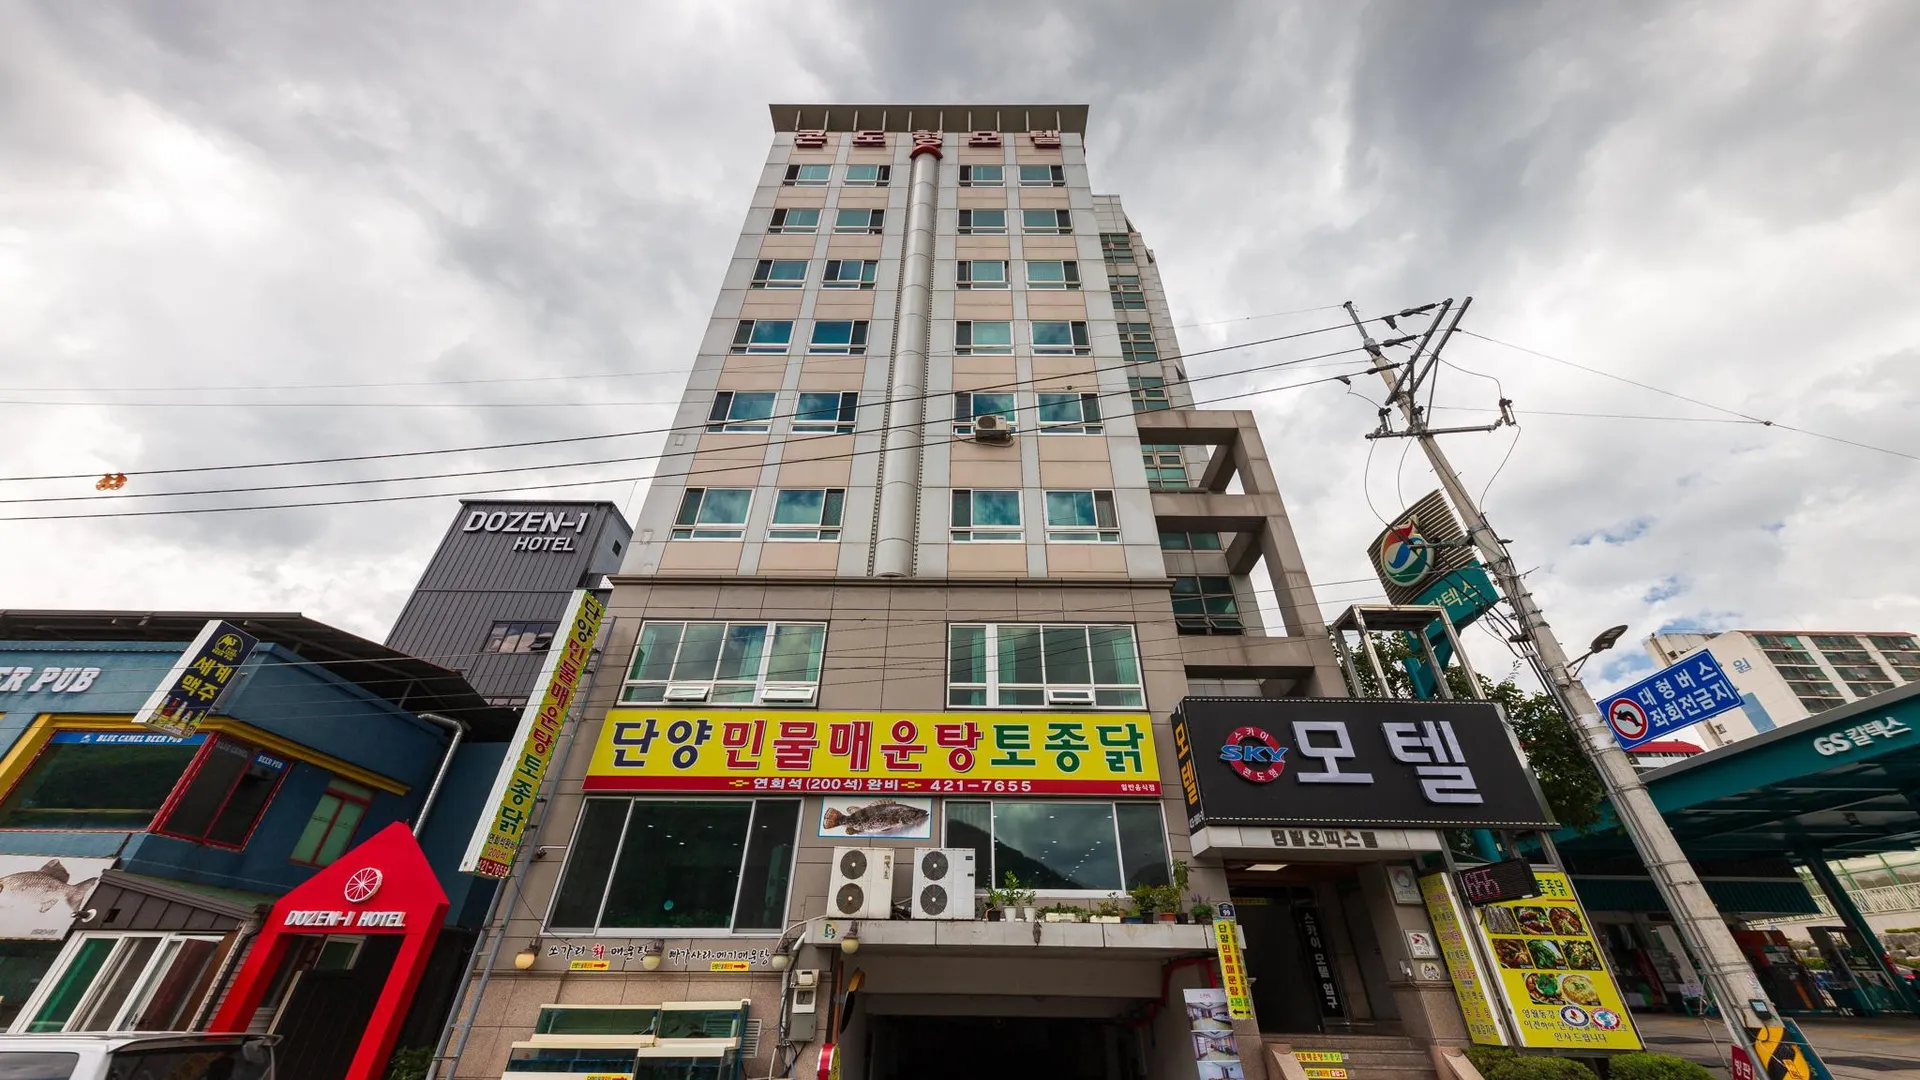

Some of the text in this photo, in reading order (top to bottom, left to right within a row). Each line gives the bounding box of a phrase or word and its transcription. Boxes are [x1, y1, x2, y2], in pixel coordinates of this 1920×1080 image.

[513, 536, 574, 551] HOTEL
[27, 667, 101, 693] PUB
[193, 656, 233, 684] 세계
[181, 674, 218, 701] 맥주
[96, 734, 118, 743] BLUE
[118, 735, 144, 743] CAMEL
[144, 735, 168, 743] BEER
[1234, 727, 1269, 741] 스카이
[1813, 716, 1912, 756] GS칼텍스
[1175, 723, 1198, 805] 모텔
[1220, 745, 1288, 763] SKY
[930, 780, 1032, 793] 421-7655
[1120, 783, 1156, 792] 일반음식점
[356, 911, 406, 927] HOTEL
[1304, 912, 1322, 949] 스카이
[548, 943, 651, 963] 쏘가리 회 매운탕
[1314, 953, 1330, 978] 모텔
[1323, 983, 1338, 1009] 입구
